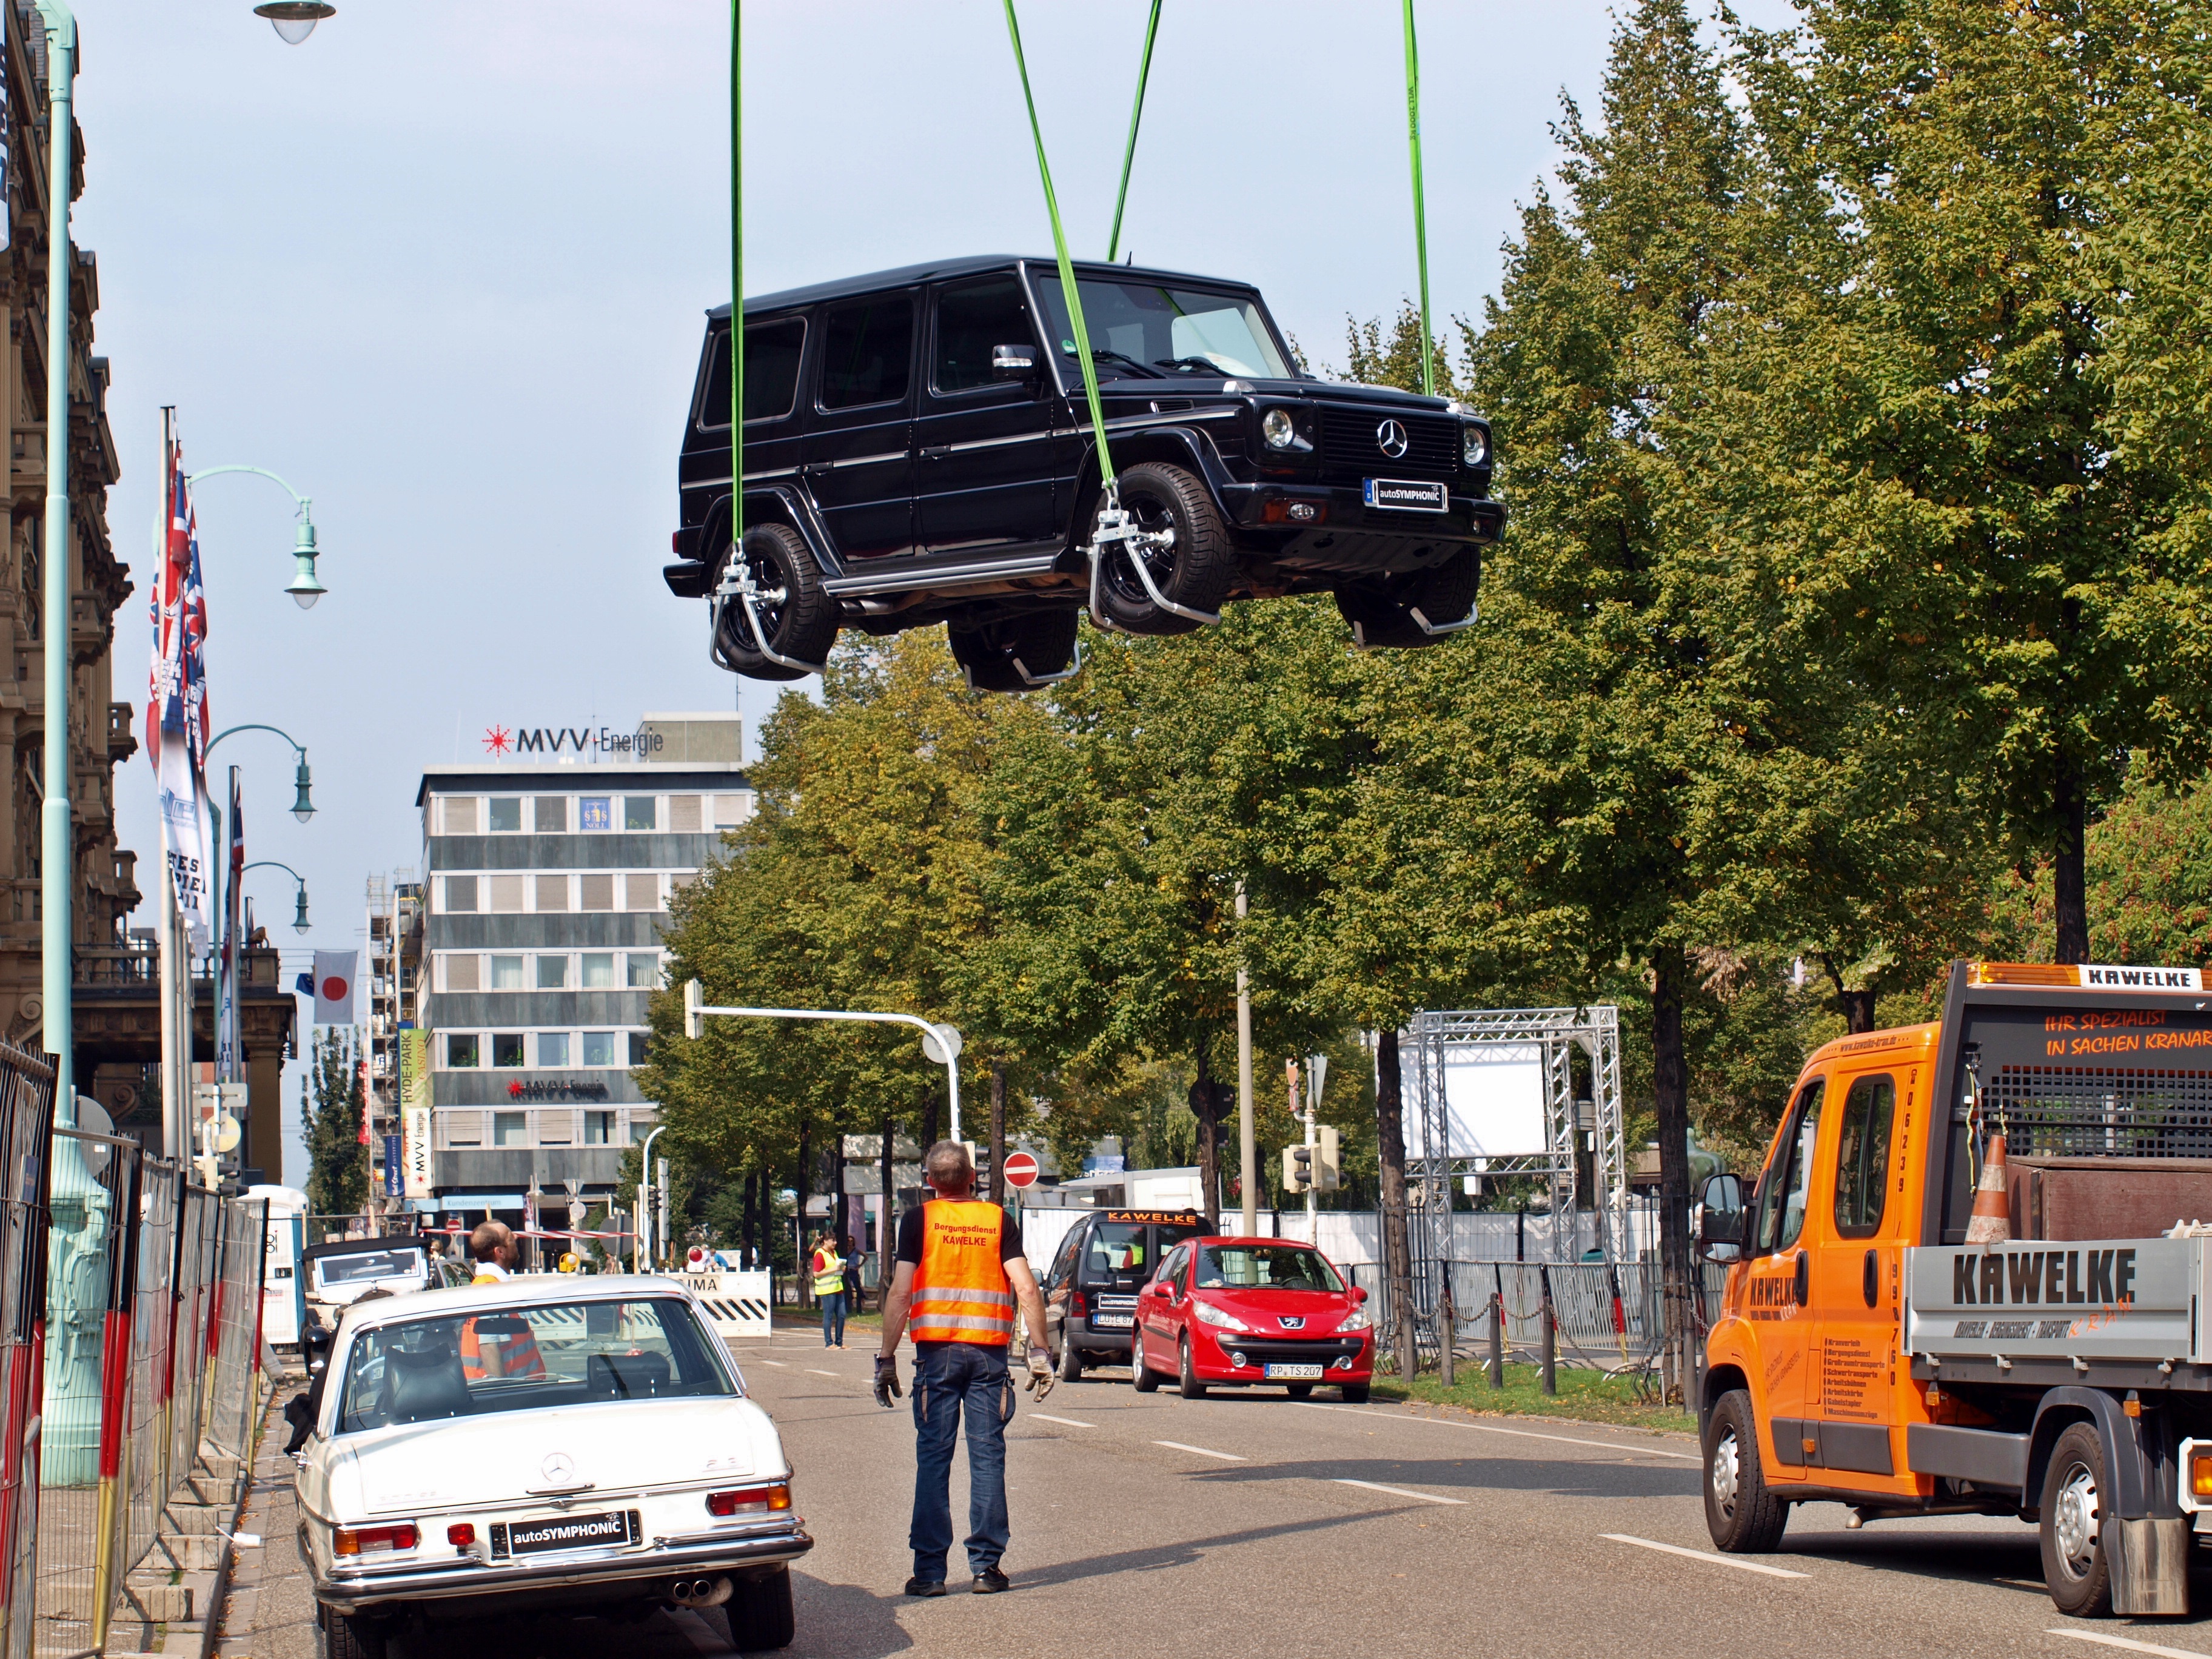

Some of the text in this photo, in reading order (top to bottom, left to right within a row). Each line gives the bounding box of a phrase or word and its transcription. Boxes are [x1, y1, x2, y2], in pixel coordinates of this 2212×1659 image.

[1379, 489, 1440, 501] autoSYMPHONIC
[517, 726, 664, 757] MVV Energie
[2088, 970, 2191, 987] KAWELKE
[2045, 1010, 2167, 1031] IHR SPEZIALIST
[2046, 1039, 2066, 1056] IN
[2071, 1034, 2140, 1055] SACHEN
[401, 1034, 412, 1103] HYDE-PARK
[417, 1039, 426, 1081] CASINO
[525, 1080, 565, 1094] MVV
[415, 1111, 426, 1171] MVV Energie
[1108, 1213, 1196, 1223] KAWELKE
[934, 1223, 997, 1234] Bergungsdienst
[942, 1235, 987, 1246] KAWELKE
[1953, 1248, 2136, 1304] KAWELKE
[1750, 1278, 1797, 1306] KAWELK
[1099, 1314, 1110, 1322] LU
[2068, 1292, 2133, 1338] KRAN
[1828, 1349, 1871, 1358] Bergungsdienst
[1270, 1366, 1321, 1376] RP TS 207
[1827, 1369, 1878, 1378] Schwertransporte
[1828, 1398, 1862, 1407] Gabelstapler
[514, 1521, 622, 1544] autoSYMPHONIC
